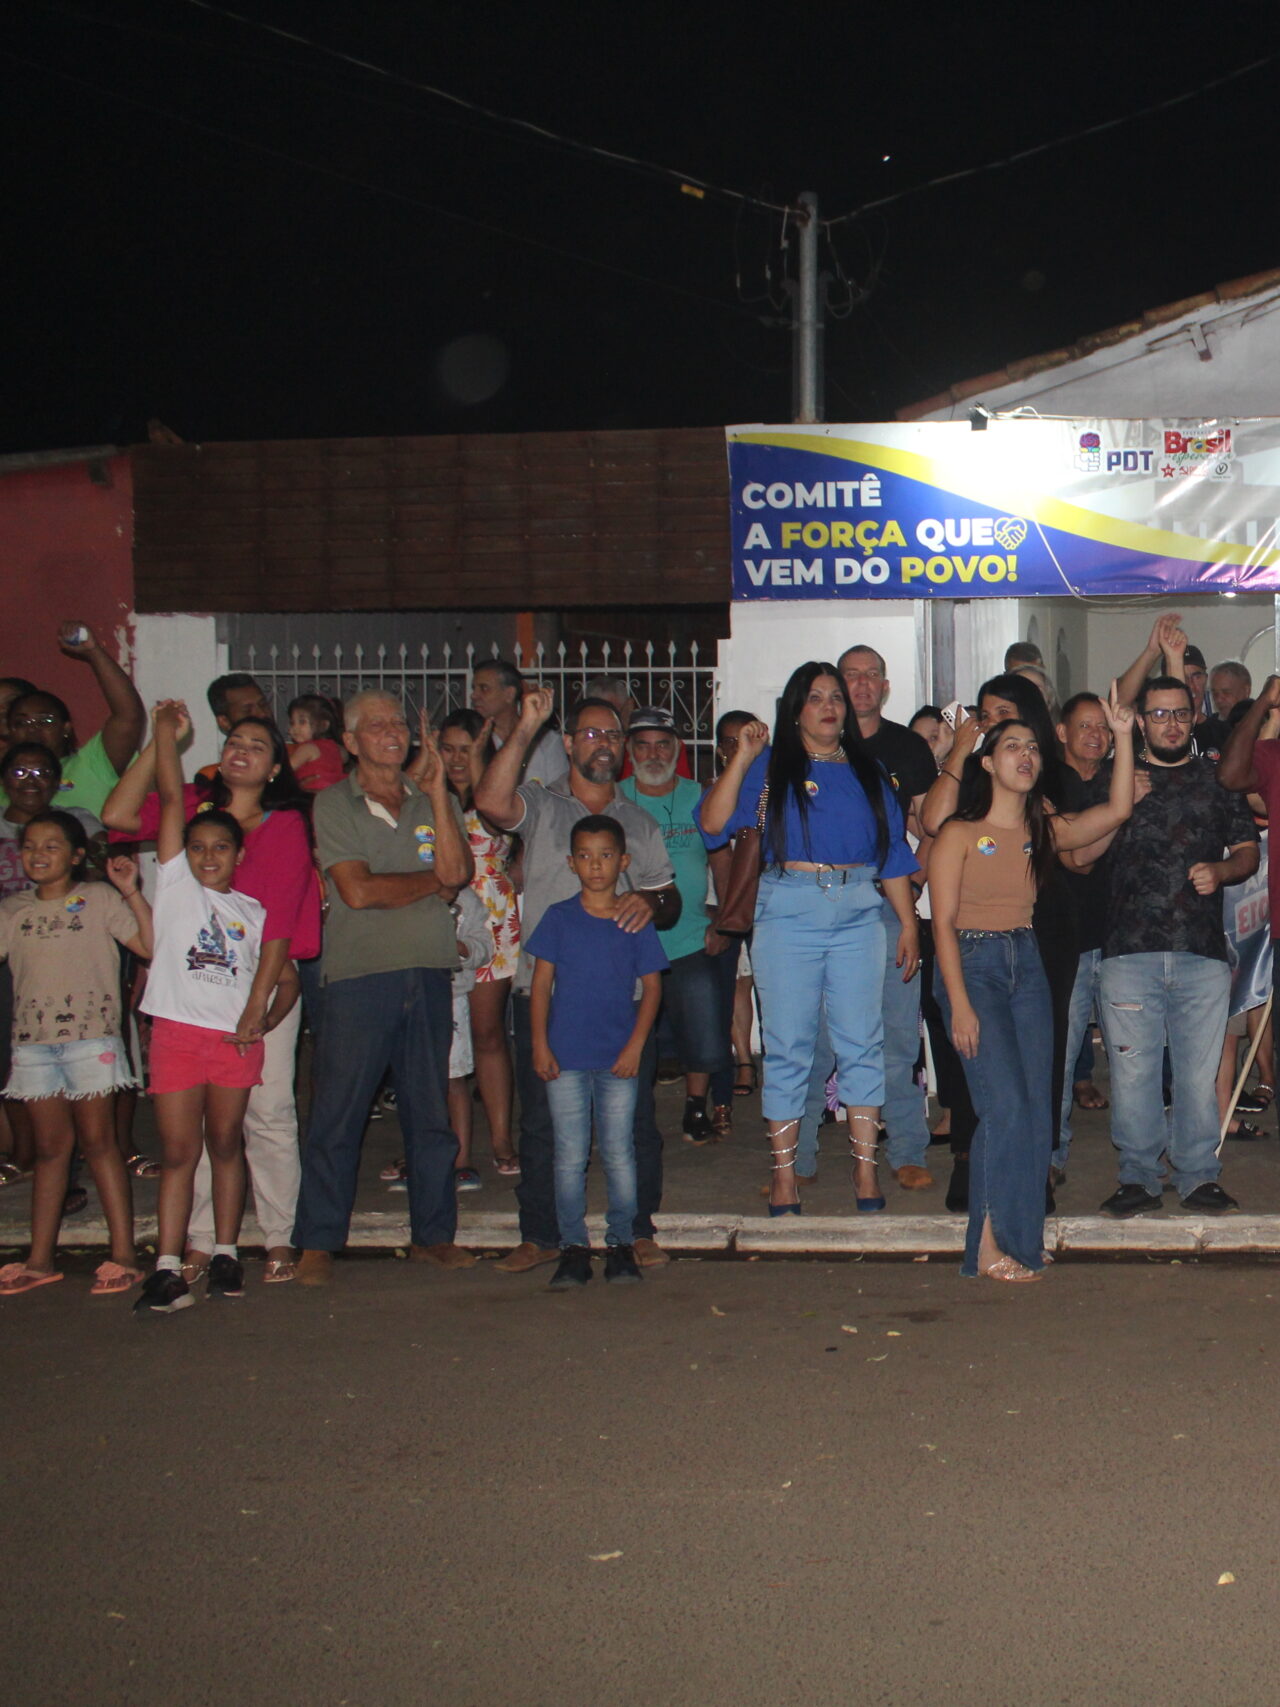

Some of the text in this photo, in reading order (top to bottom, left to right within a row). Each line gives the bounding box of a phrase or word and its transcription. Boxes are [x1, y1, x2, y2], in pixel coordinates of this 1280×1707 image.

[1164, 428, 1231, 454] Brasil
[1107, 451, 1154, 471] PDT
[742, 473, 882, 509] COMITÊ
[743, 518, 994, 555] A FORÇA QUE
[744, 555, 1018, 586] VEM DO POVO!
